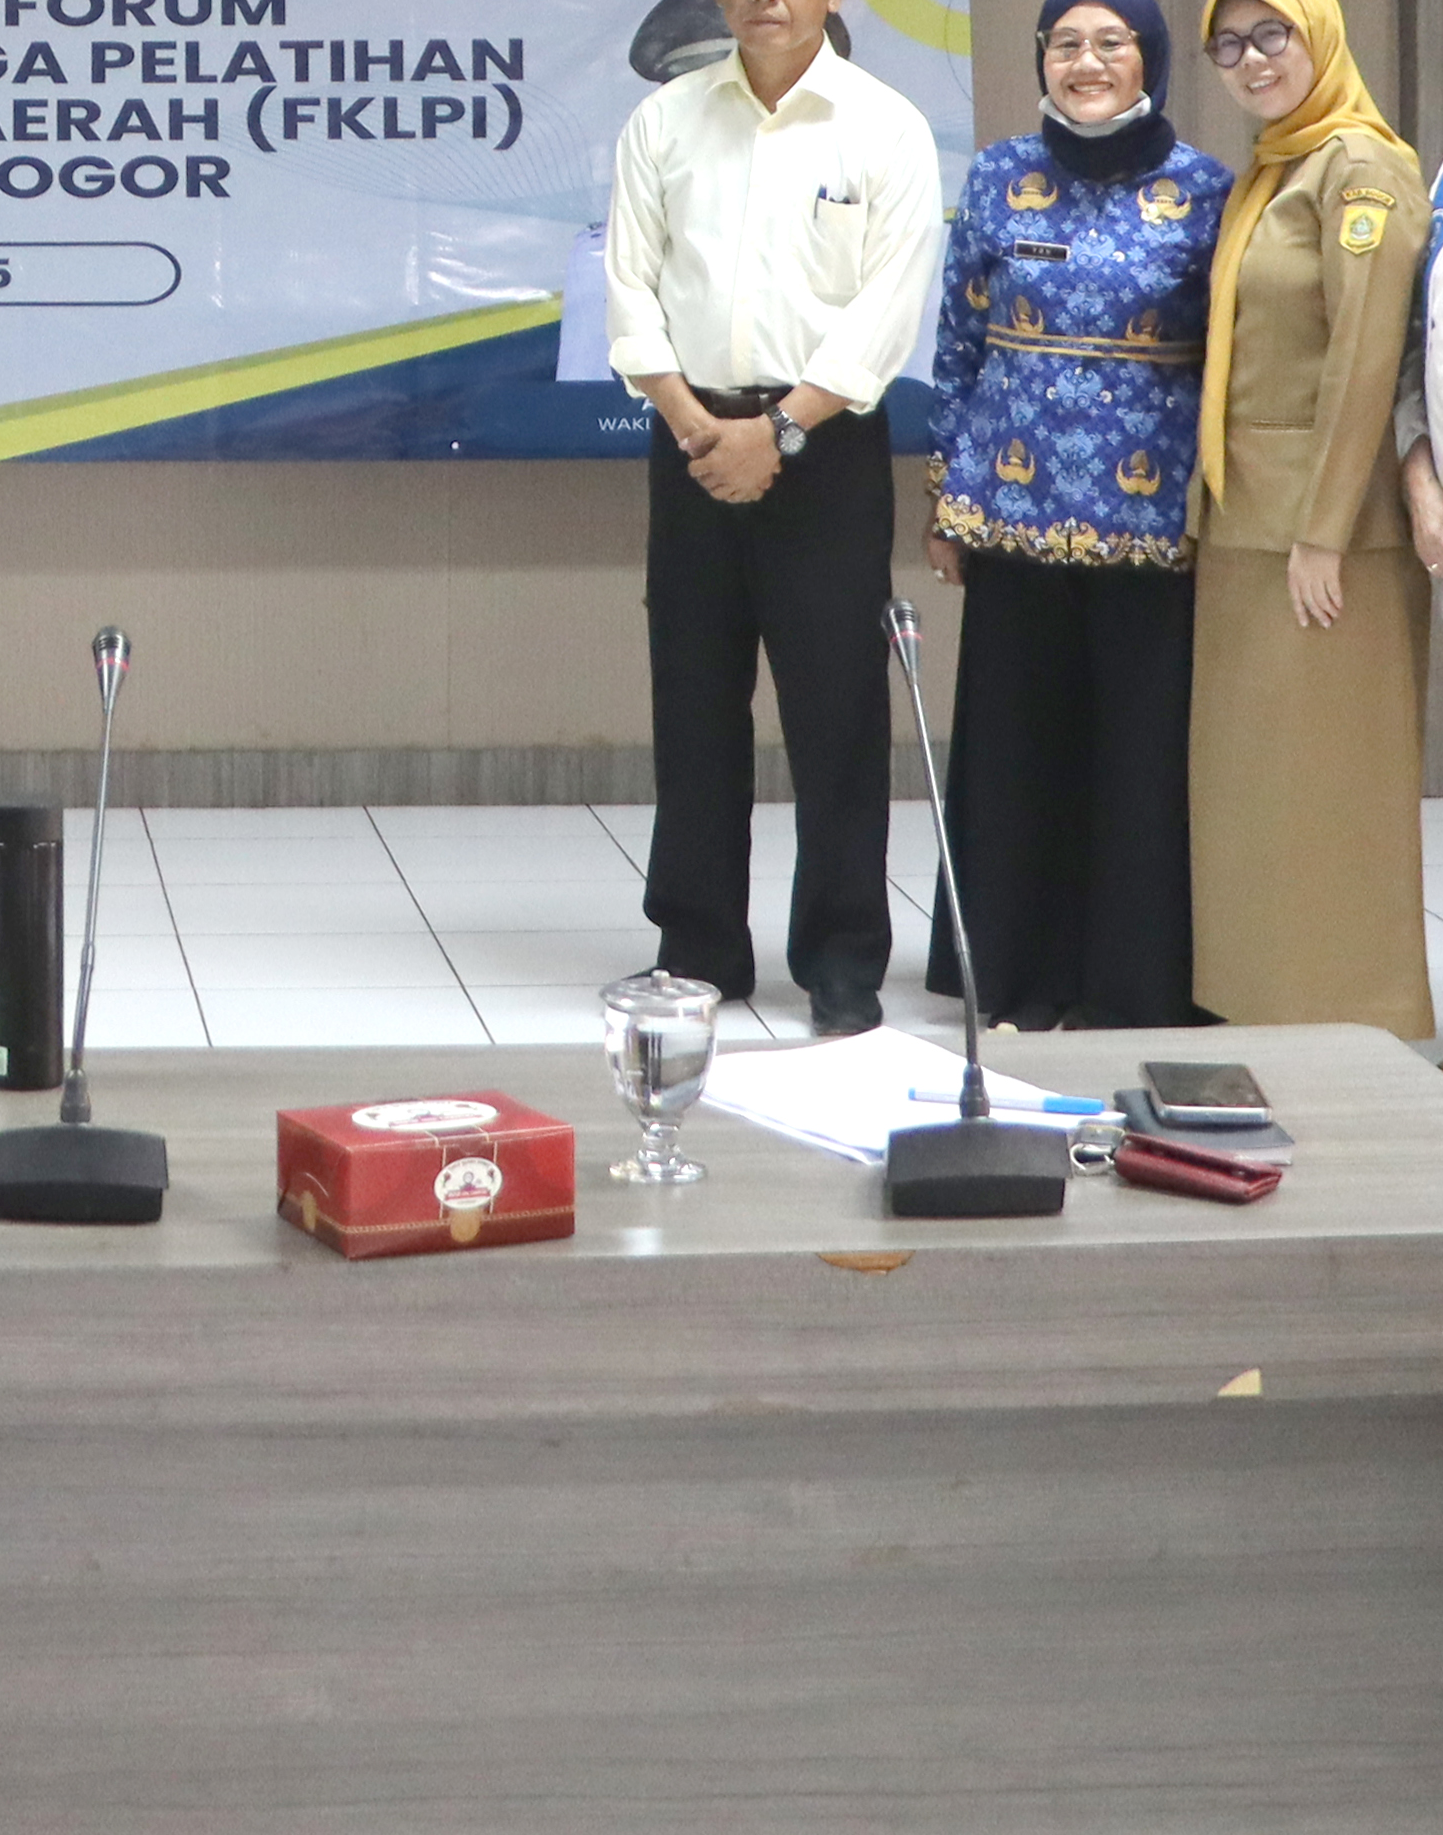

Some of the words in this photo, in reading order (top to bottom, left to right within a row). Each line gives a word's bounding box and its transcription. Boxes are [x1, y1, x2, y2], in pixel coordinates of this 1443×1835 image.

[90, 38, 524, 84] PELATIHAN
[246, 83, 524, 153] (FKLPI)
[598, 417, 651, 431] WAKI
